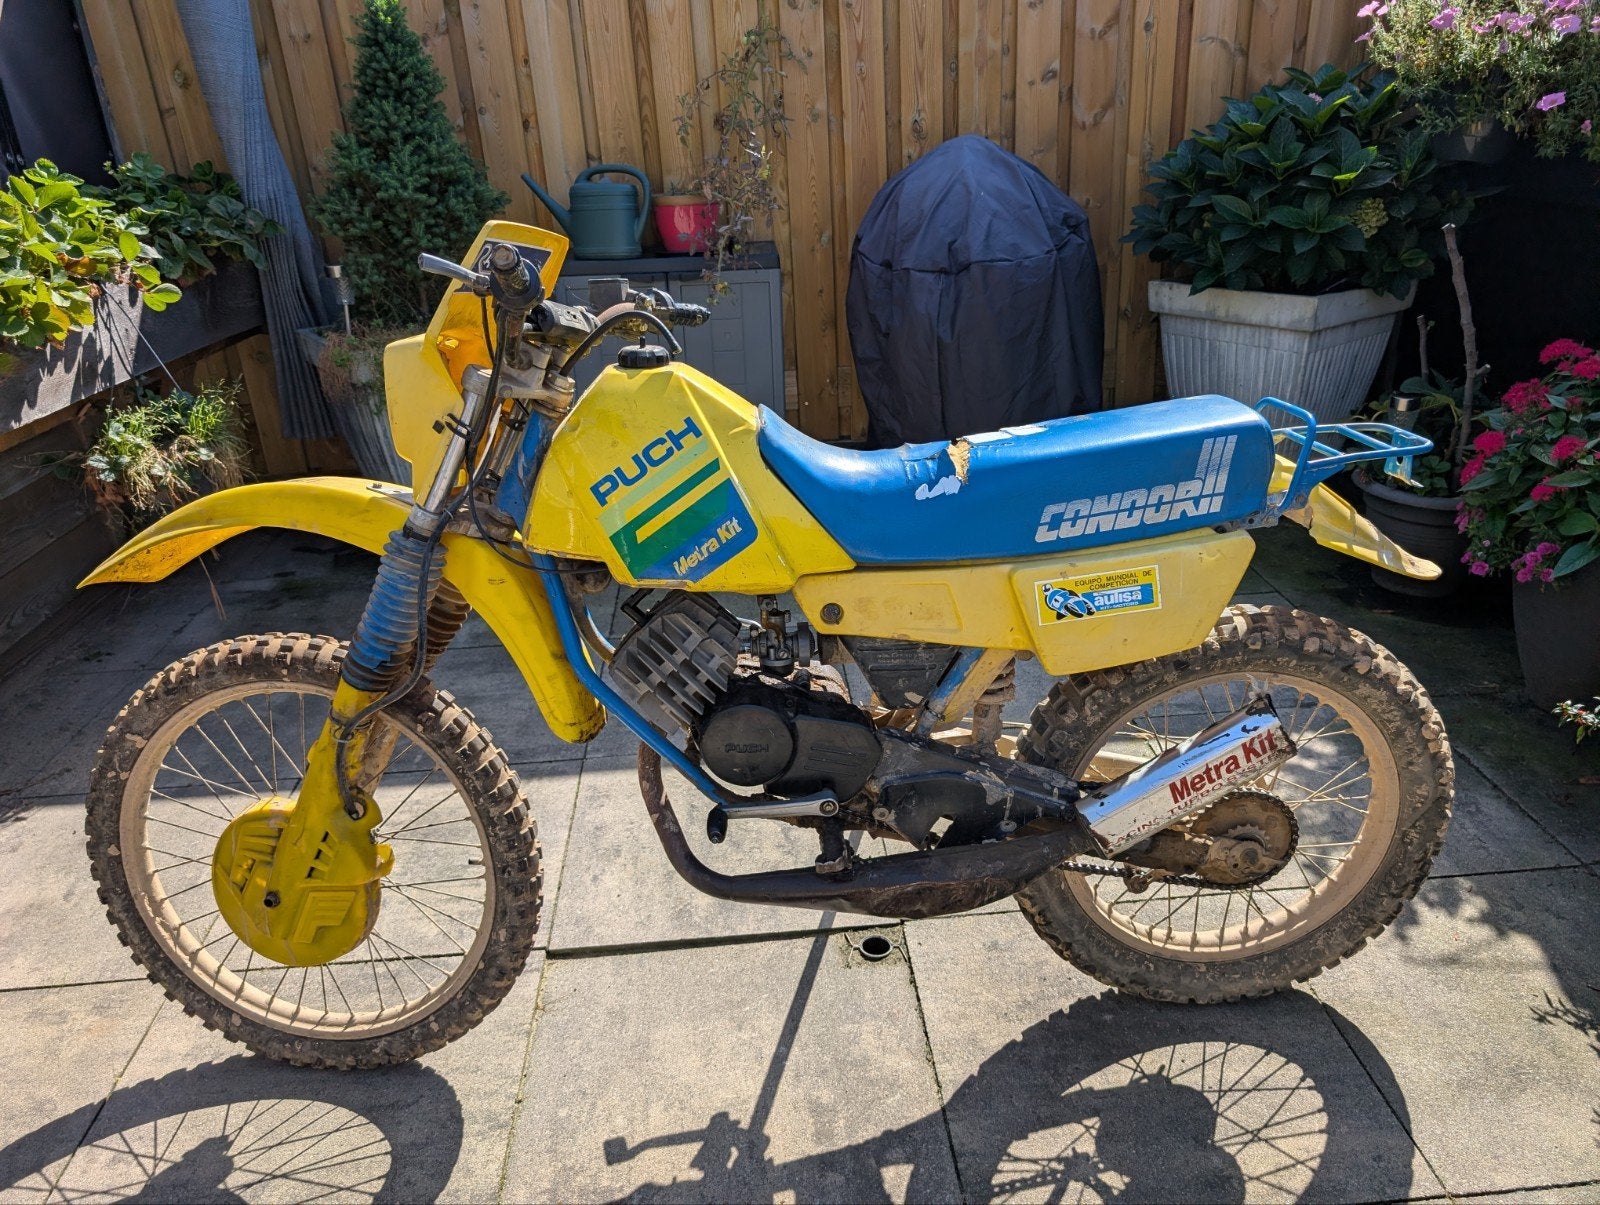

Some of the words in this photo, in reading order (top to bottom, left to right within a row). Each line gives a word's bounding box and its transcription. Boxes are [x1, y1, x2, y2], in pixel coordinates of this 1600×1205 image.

[589, 416, 703, 507] PUCH
[672, 535, 720, 576] Metra
[716, 516, 743, 544] Kit
[1074, 577, 1102, 587] EQUIPO
[1106, 573, 1139, 582] MUNDIAL
[1142, 569, 1153, 577] DE
[1089, 578, 1139, 591] COMPETICION
[724, 742, 769, 753] PUCH
[1168, 753, 1241, 804] Metra
[1241, 729, 1278, 764] Kit
